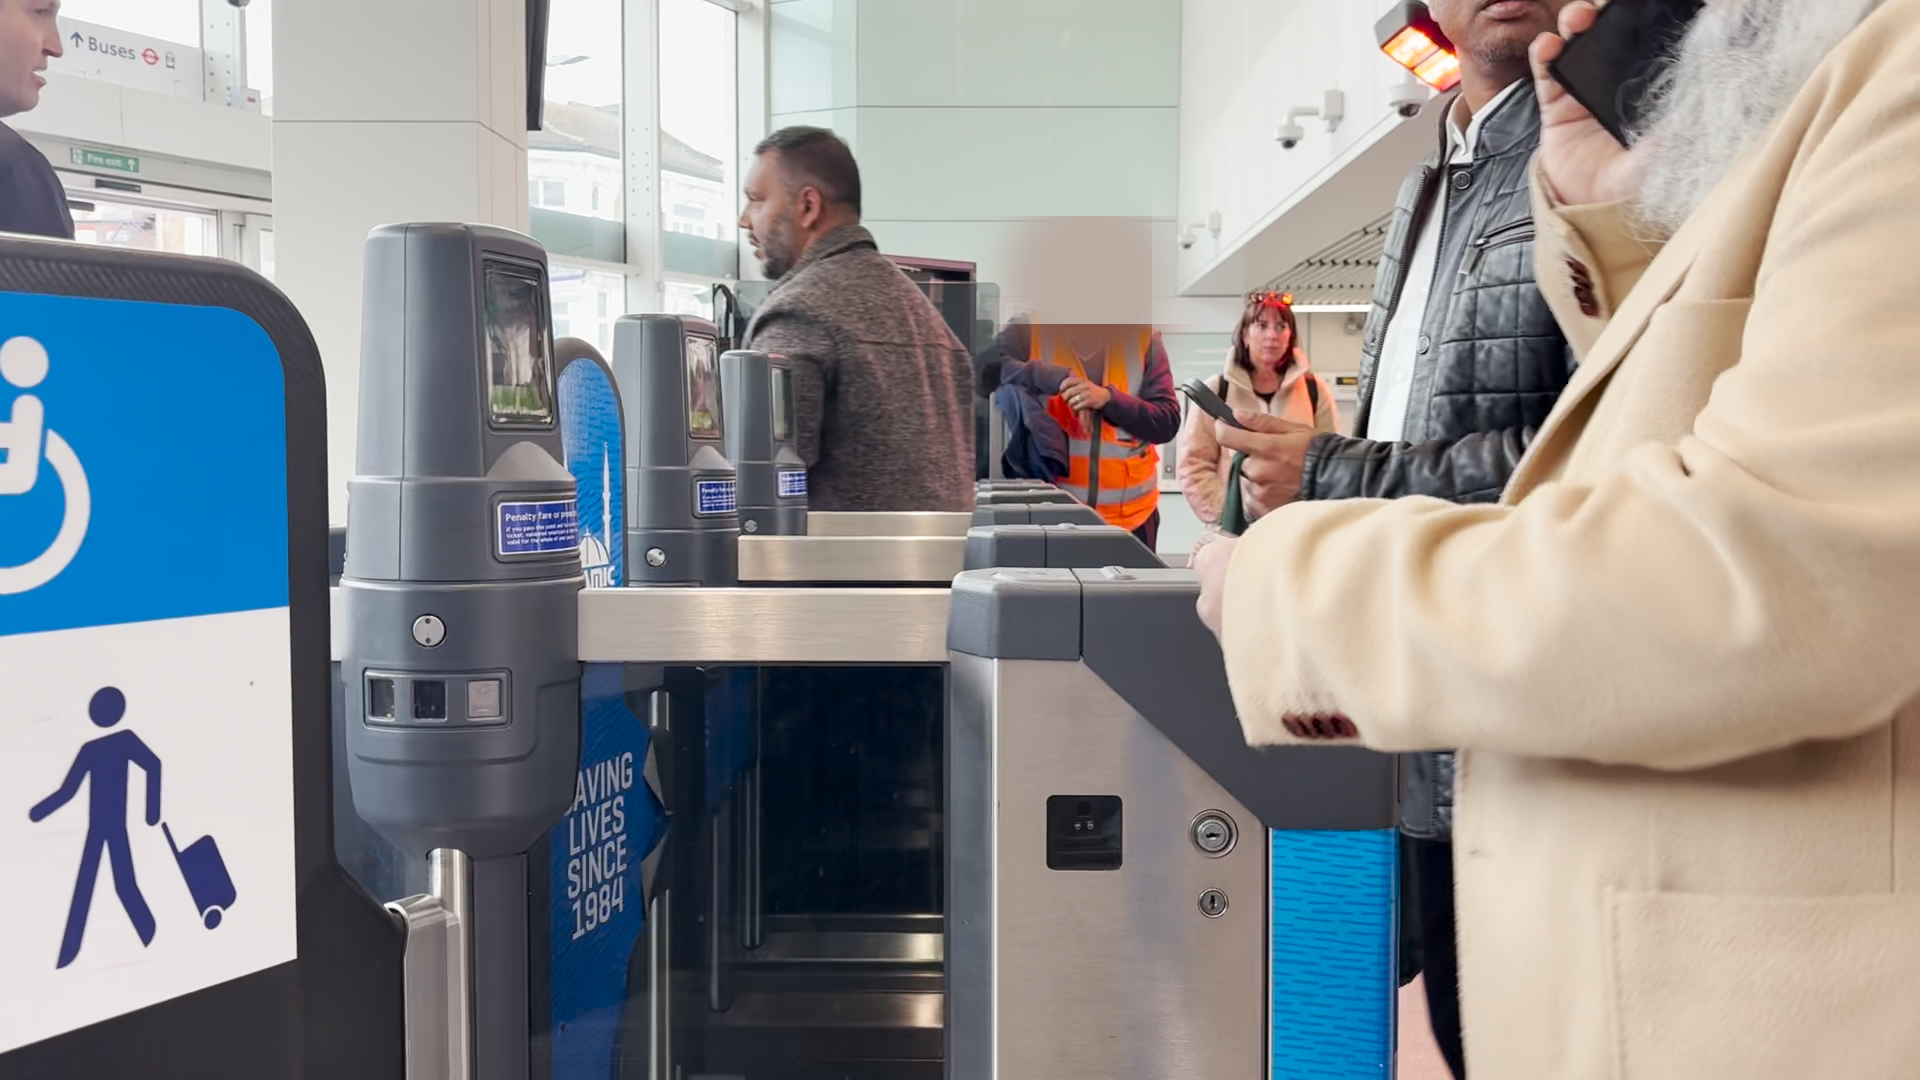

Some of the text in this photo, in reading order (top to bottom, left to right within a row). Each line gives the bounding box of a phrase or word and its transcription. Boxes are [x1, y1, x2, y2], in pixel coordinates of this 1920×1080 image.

[88, 36, 136, 60] Buses
[505, 512, 536, 522] Penalty
[538, 511, 552, 520] fare
[564, 752, 633, 816] AVING
[569, 795, 625, 856] LIVES
[567, 833, 627, 899] SINCE
[572, 876, 624, 941] 1984
